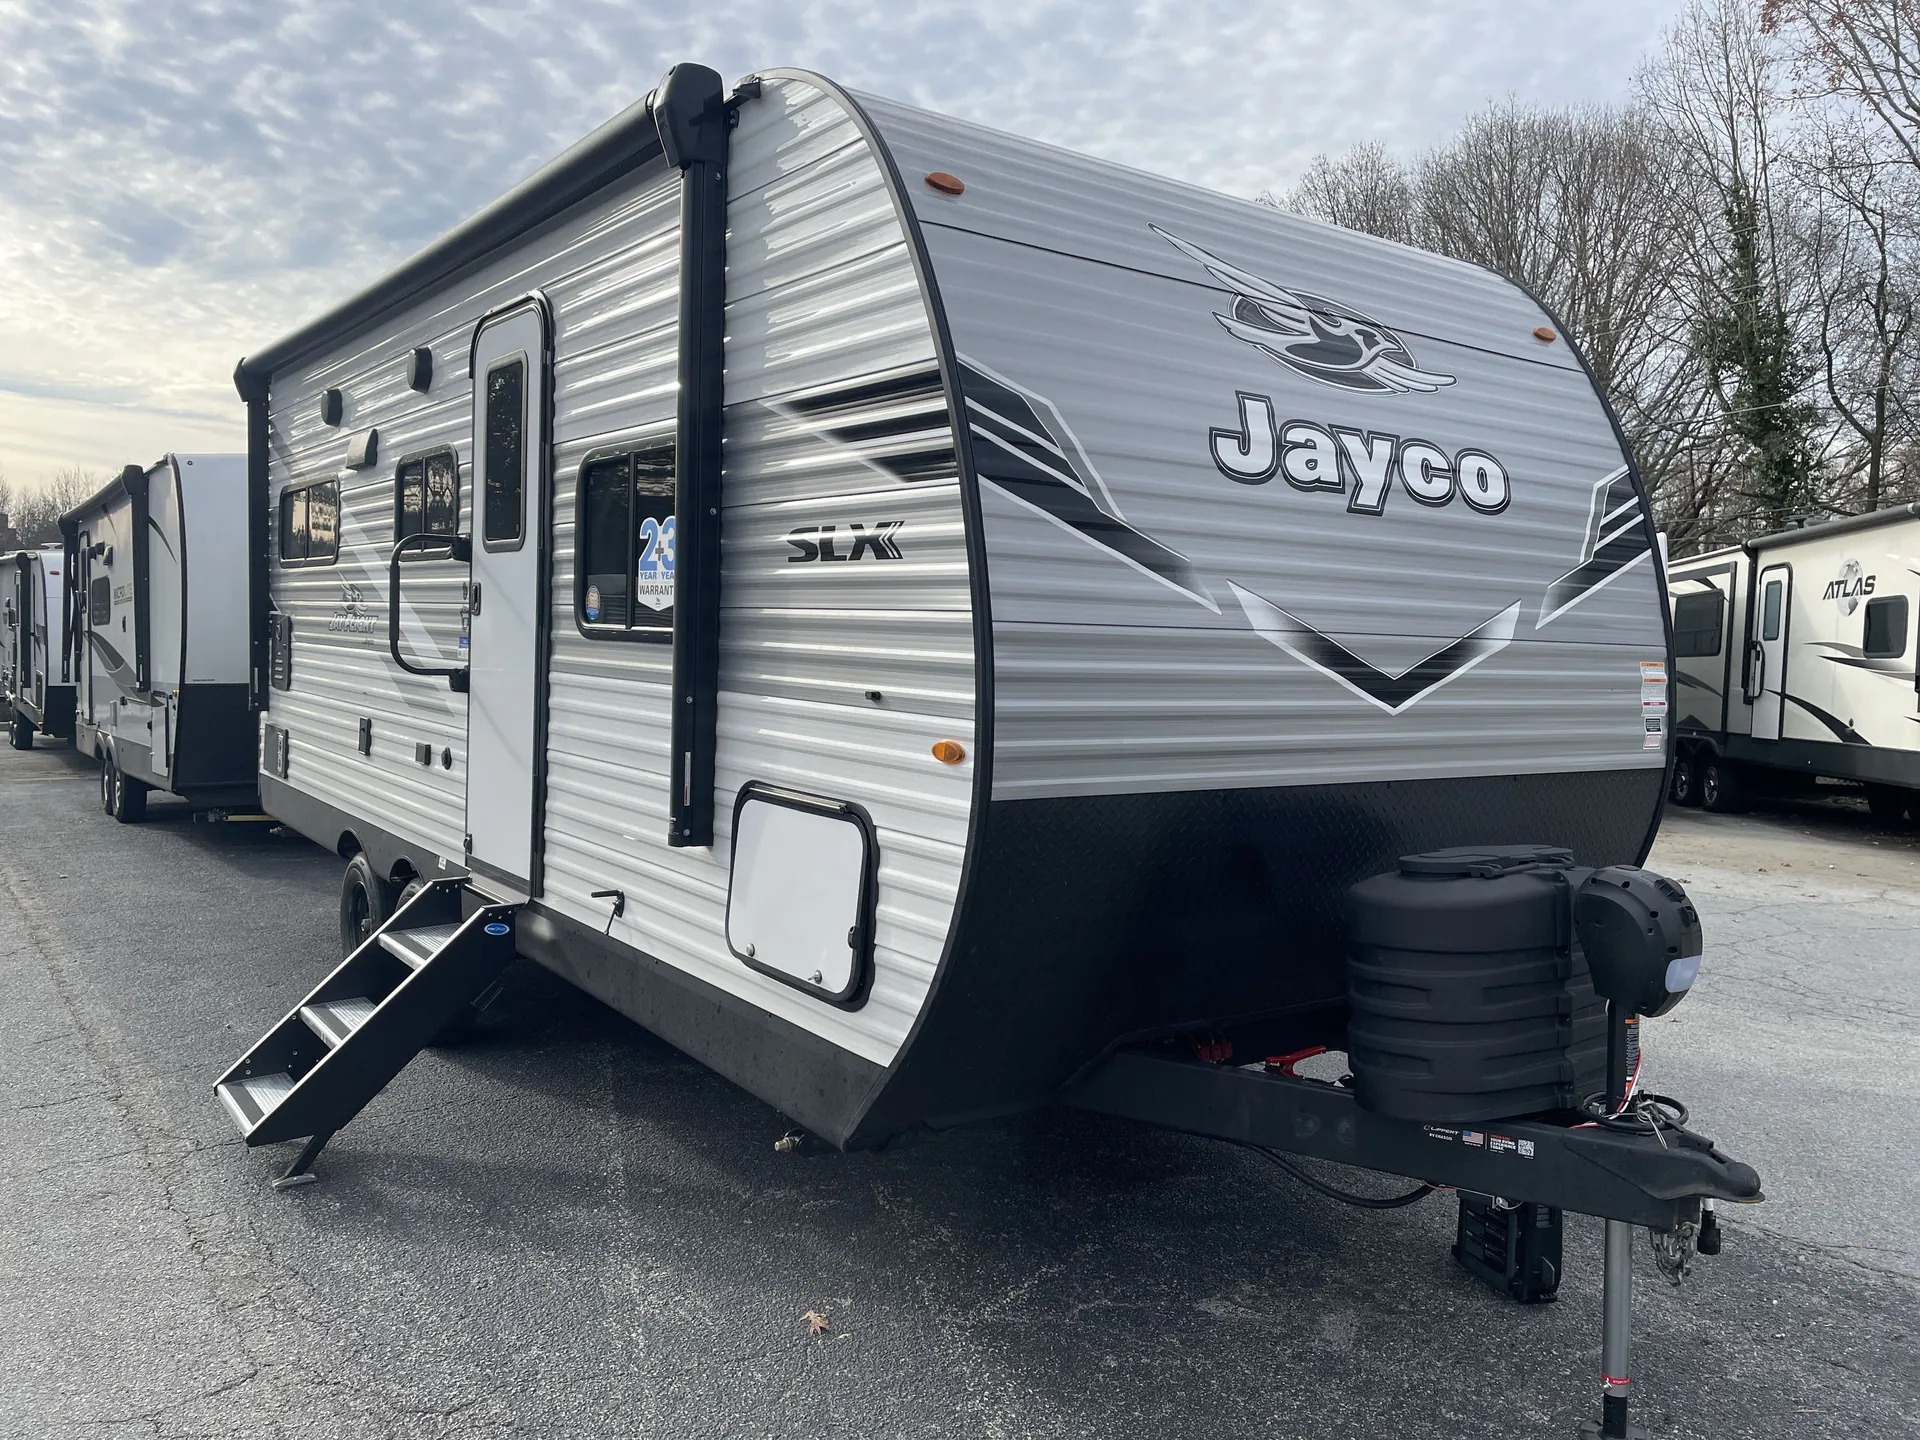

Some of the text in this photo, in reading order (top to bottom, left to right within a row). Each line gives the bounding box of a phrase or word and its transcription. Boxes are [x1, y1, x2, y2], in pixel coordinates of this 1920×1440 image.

[1209, 390, 1511, 516] Jayco
[787, 520, 904, 562] SLX
[640, 571, 674, 580] YEAR YEA
[1822, 575, 1876, 600] ATLAS
[639, 585, 674, 596] WARRANT
